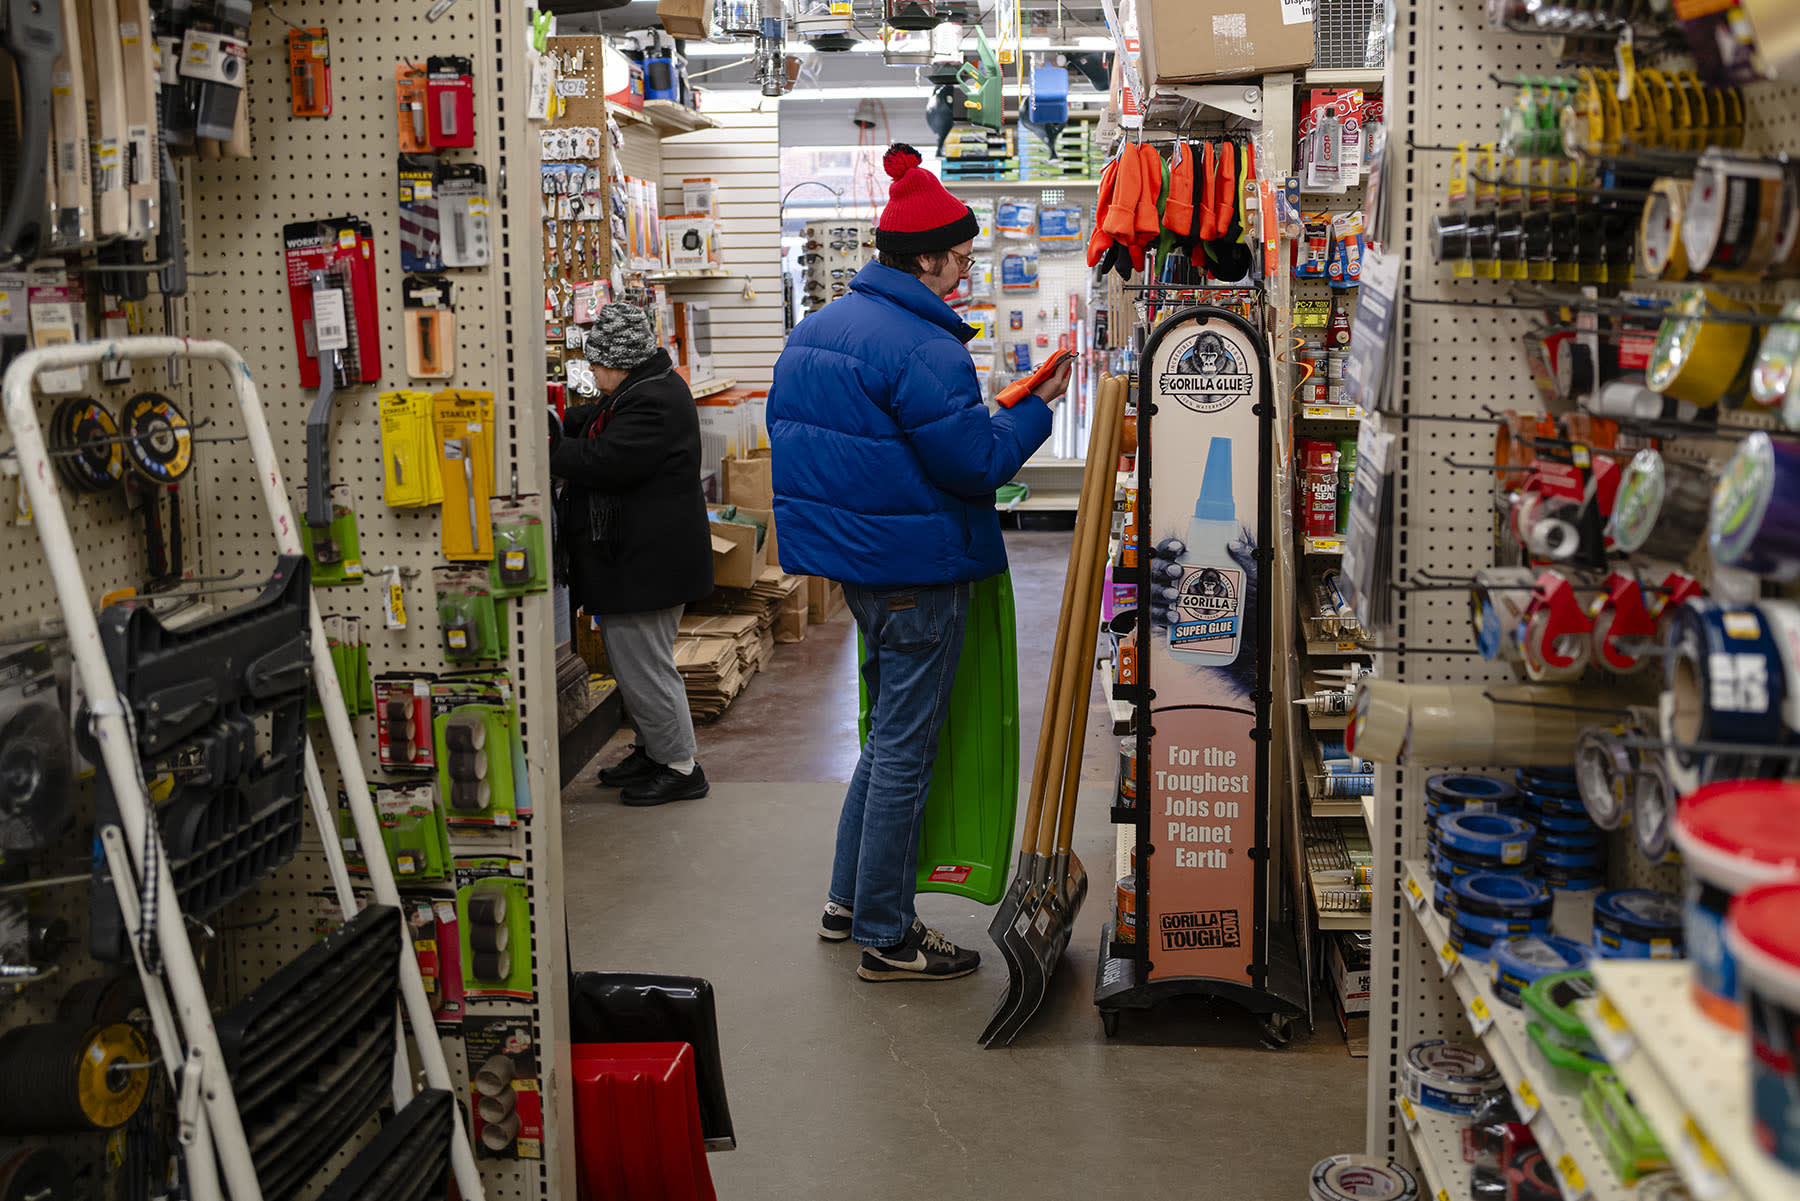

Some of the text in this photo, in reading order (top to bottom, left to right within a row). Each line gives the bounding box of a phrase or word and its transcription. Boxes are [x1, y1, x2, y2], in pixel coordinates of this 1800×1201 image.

[1323, 134, 1331, 161] GOOP
[1169, 378, 1243, 391] GORILLA GLUE
[440, 410, 477, 419] STANLEY
[1183, 596, 1230, 609] GORILLA
[1175, 621, 1233, 638] SUPER GLUE
[1168, 745, 1237, 767] For the
[1155, 770, 1249, 794] Toughest
[1164, 796, 1240, 818] Jobs on
[1167, 822, 1232, 843] Planet
[1175, 847, 1227, 869] Earth
[1162, 913, 1220, 929] GORILLA
[1164, 930, 1222, 948] TOUGH
